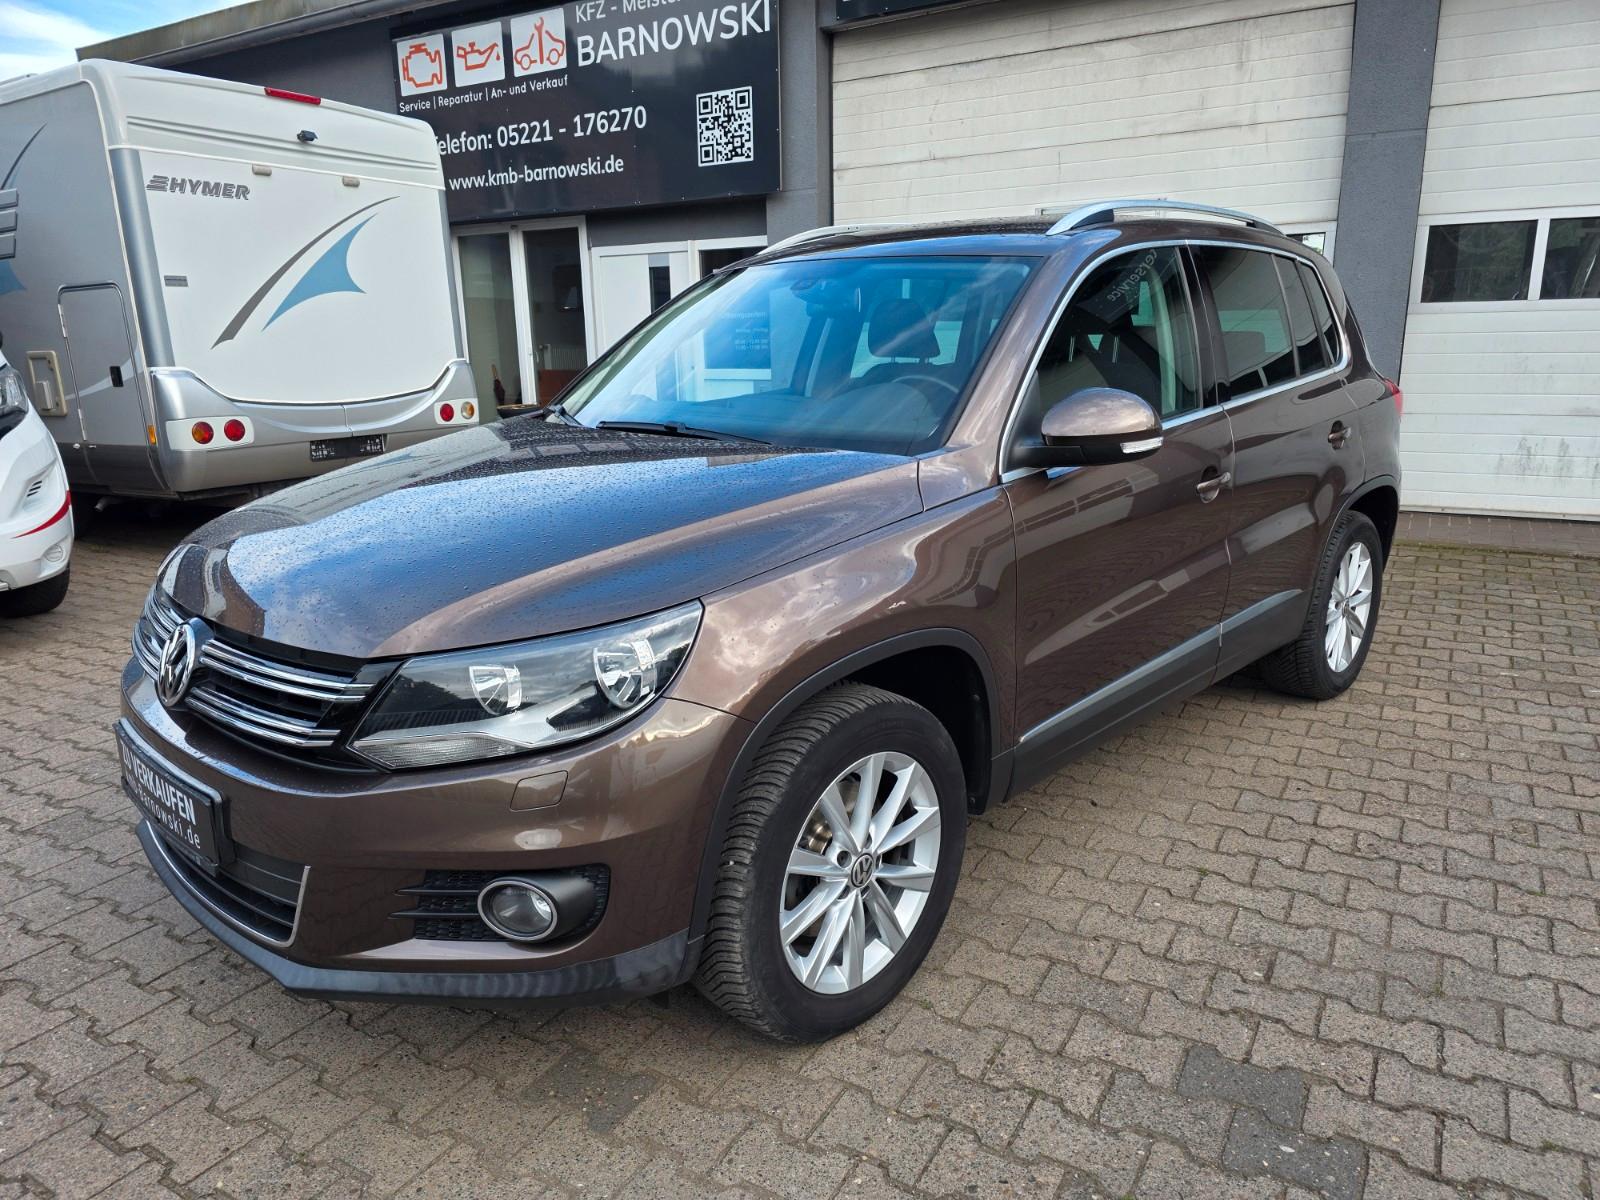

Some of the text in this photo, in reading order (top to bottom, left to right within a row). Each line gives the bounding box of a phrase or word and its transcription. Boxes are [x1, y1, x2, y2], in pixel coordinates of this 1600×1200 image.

[575, 0, 606, 23] KFZ
[577, 0, 771, 67] BARNOWSKI
[399, 99, 431, 113] Service
[438, 91, 483, 108] Reparatur
[490, 87, 507, 99] An-
[509, 83, 527, 96] und
[529, 74, 569, 91] Verkauf
[436, 131, 493, 156] elefon:
[497, 119, 553, 148] 05221
[573, 105, 647, 138] 176270
[169, 176, 250, 201] HYMER
[448, 154, 625, 191] www.kmb-barnowski.de
[129, 751, 196, 825] VERKAUFEN
